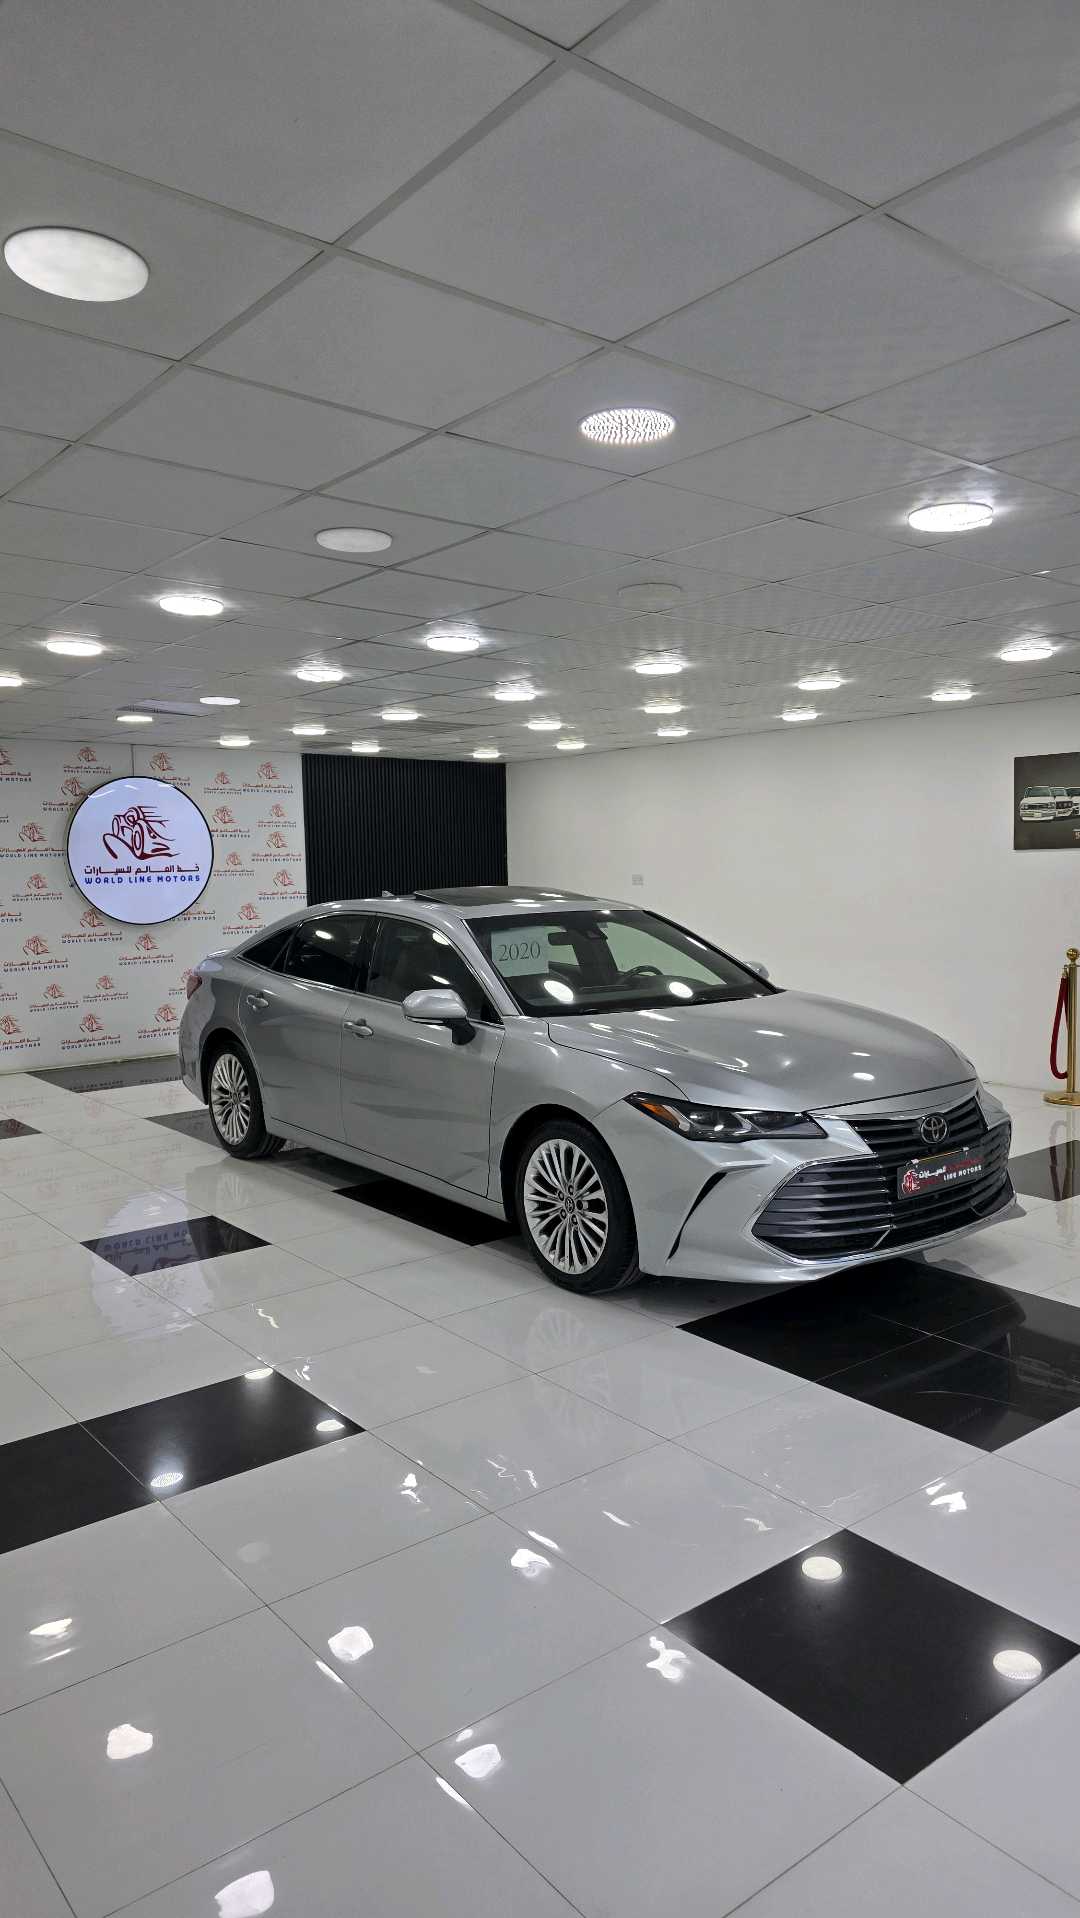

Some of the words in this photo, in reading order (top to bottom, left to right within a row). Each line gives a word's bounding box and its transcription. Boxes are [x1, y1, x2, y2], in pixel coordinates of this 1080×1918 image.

[84, 865, 132, 876] للسيارات
[135, 865, 175, 875] العالم
[177, 863, 200, 873] خط
[498, 941, 541, 962] 2020
[959, 1164, 982, 1177] MOTORS
